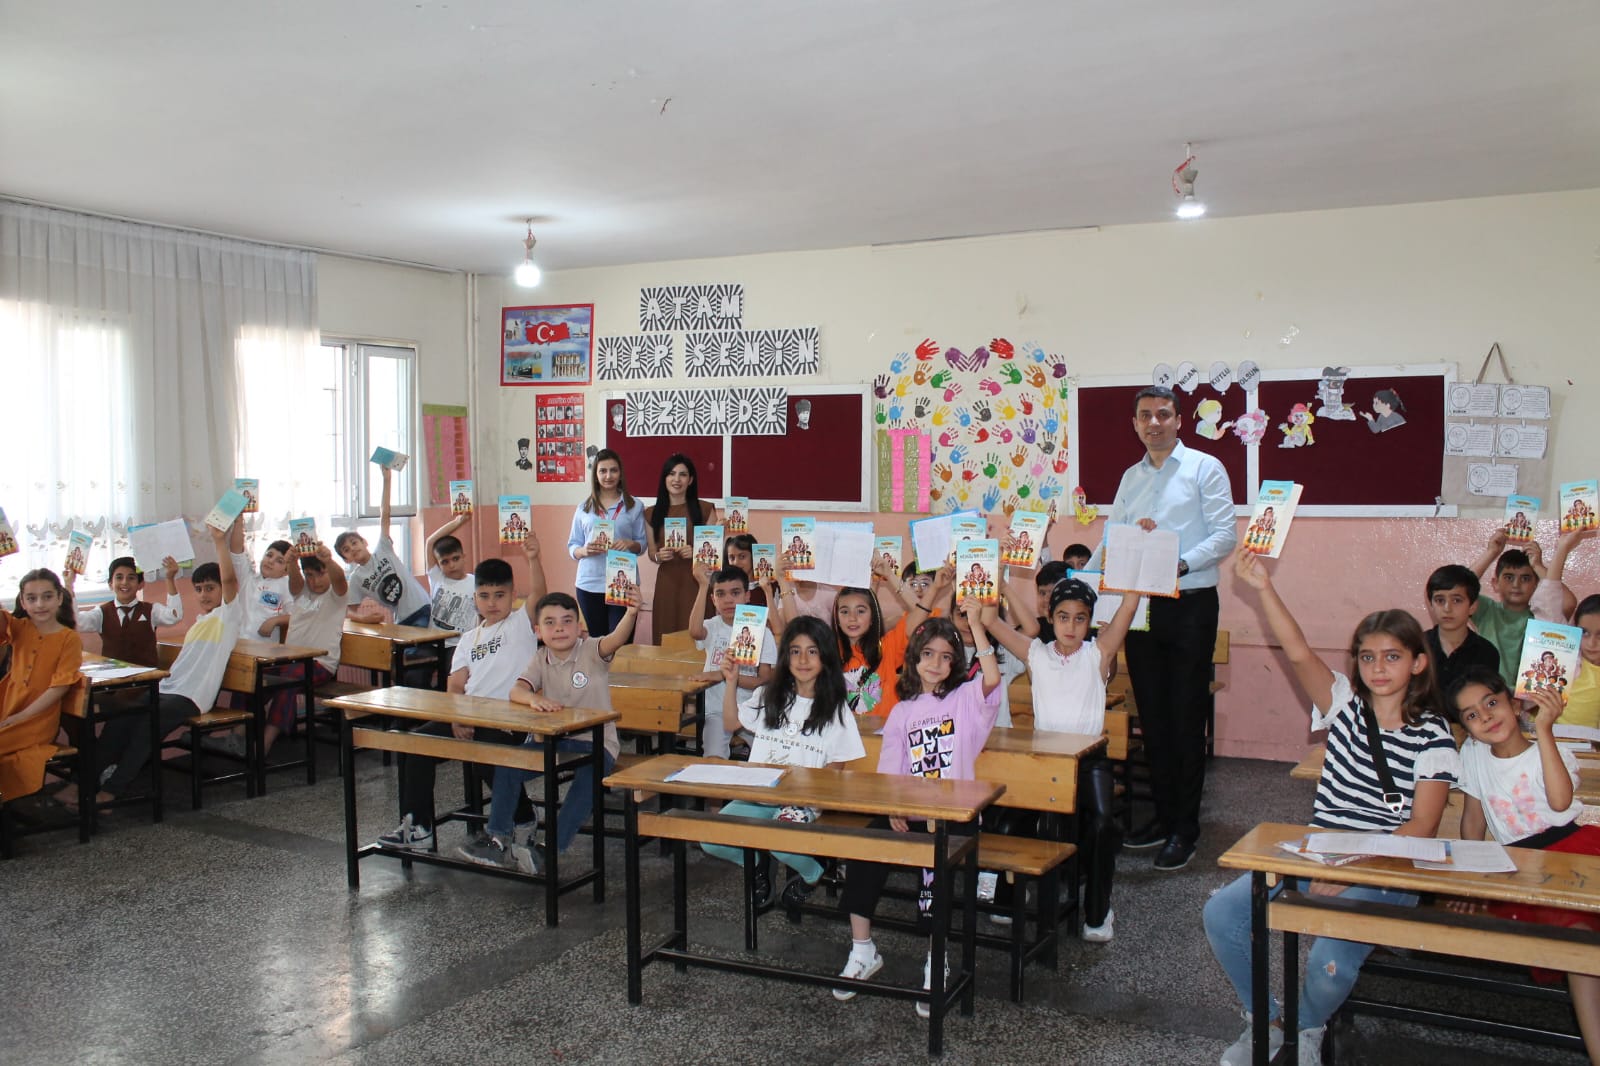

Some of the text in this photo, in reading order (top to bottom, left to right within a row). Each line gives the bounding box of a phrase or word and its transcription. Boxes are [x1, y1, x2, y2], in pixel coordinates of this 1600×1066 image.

[646, 294, 741, 321] ATAM
[605, 343, 670, 370] HEP
[1210, 366, 1231, 386] KUTLU
[1239, 366, 1260, 386] OLSUN
